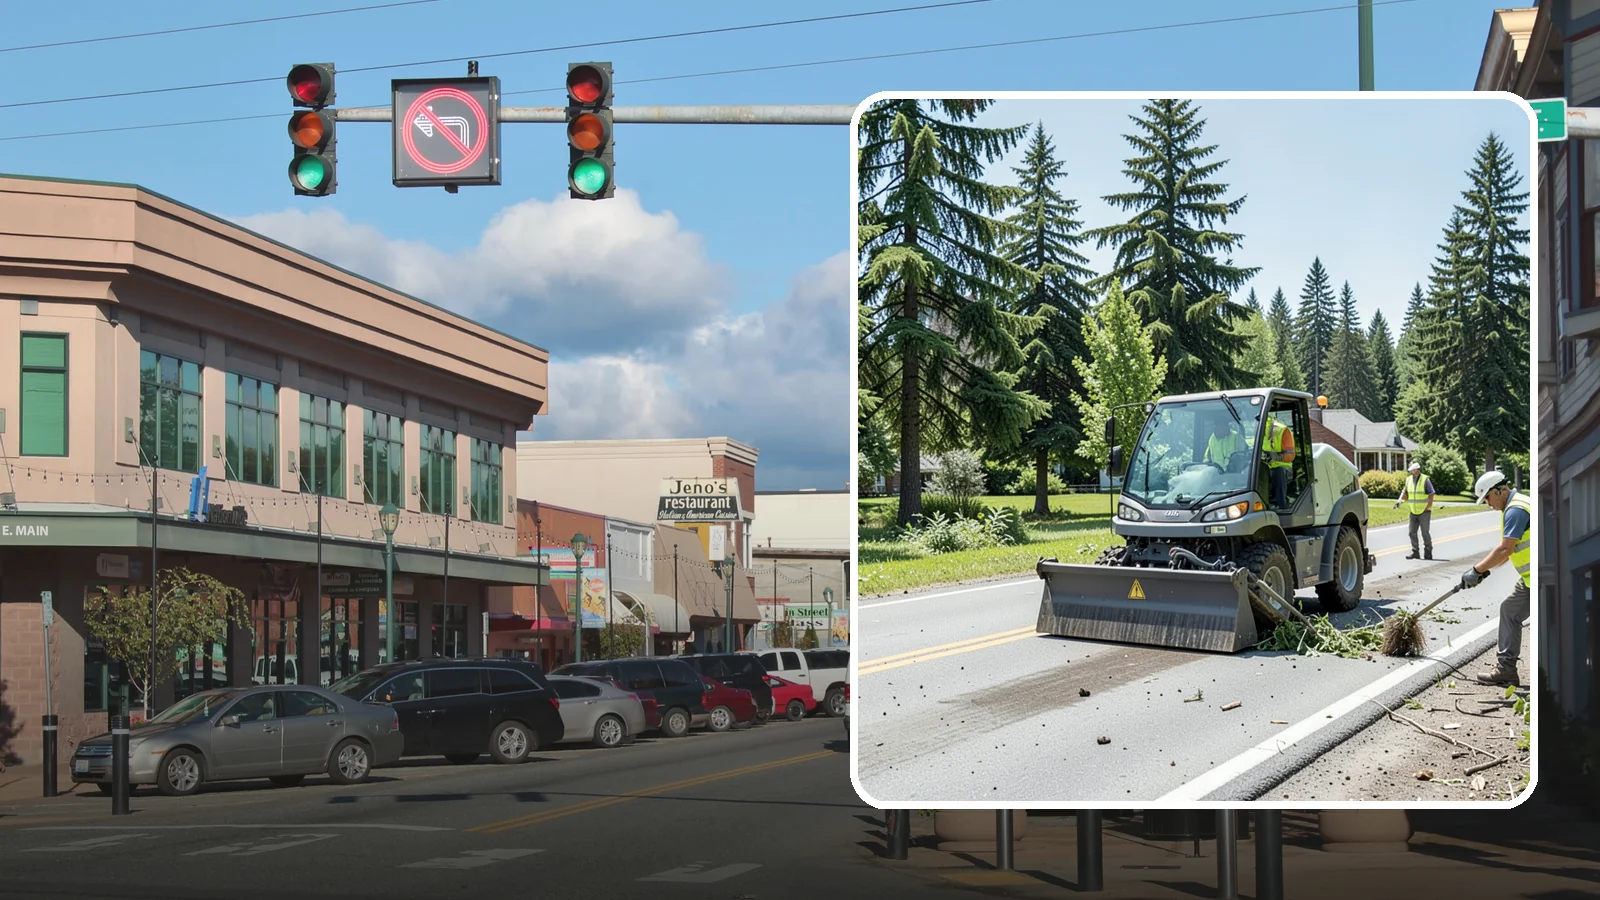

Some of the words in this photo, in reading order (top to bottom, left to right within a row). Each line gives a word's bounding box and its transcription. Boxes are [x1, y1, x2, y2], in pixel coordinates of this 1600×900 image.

[669, 480, 727, 494] Jeno's
[665, 497, 731, 509] restaurant
[686, 510, 714, 519] American
[715, 510, 737, 519] Cuisine
[2, 525, 13, 536] E.
[15, 525, 49, 536] MAIN
[790, 619, 824, 627] lass
